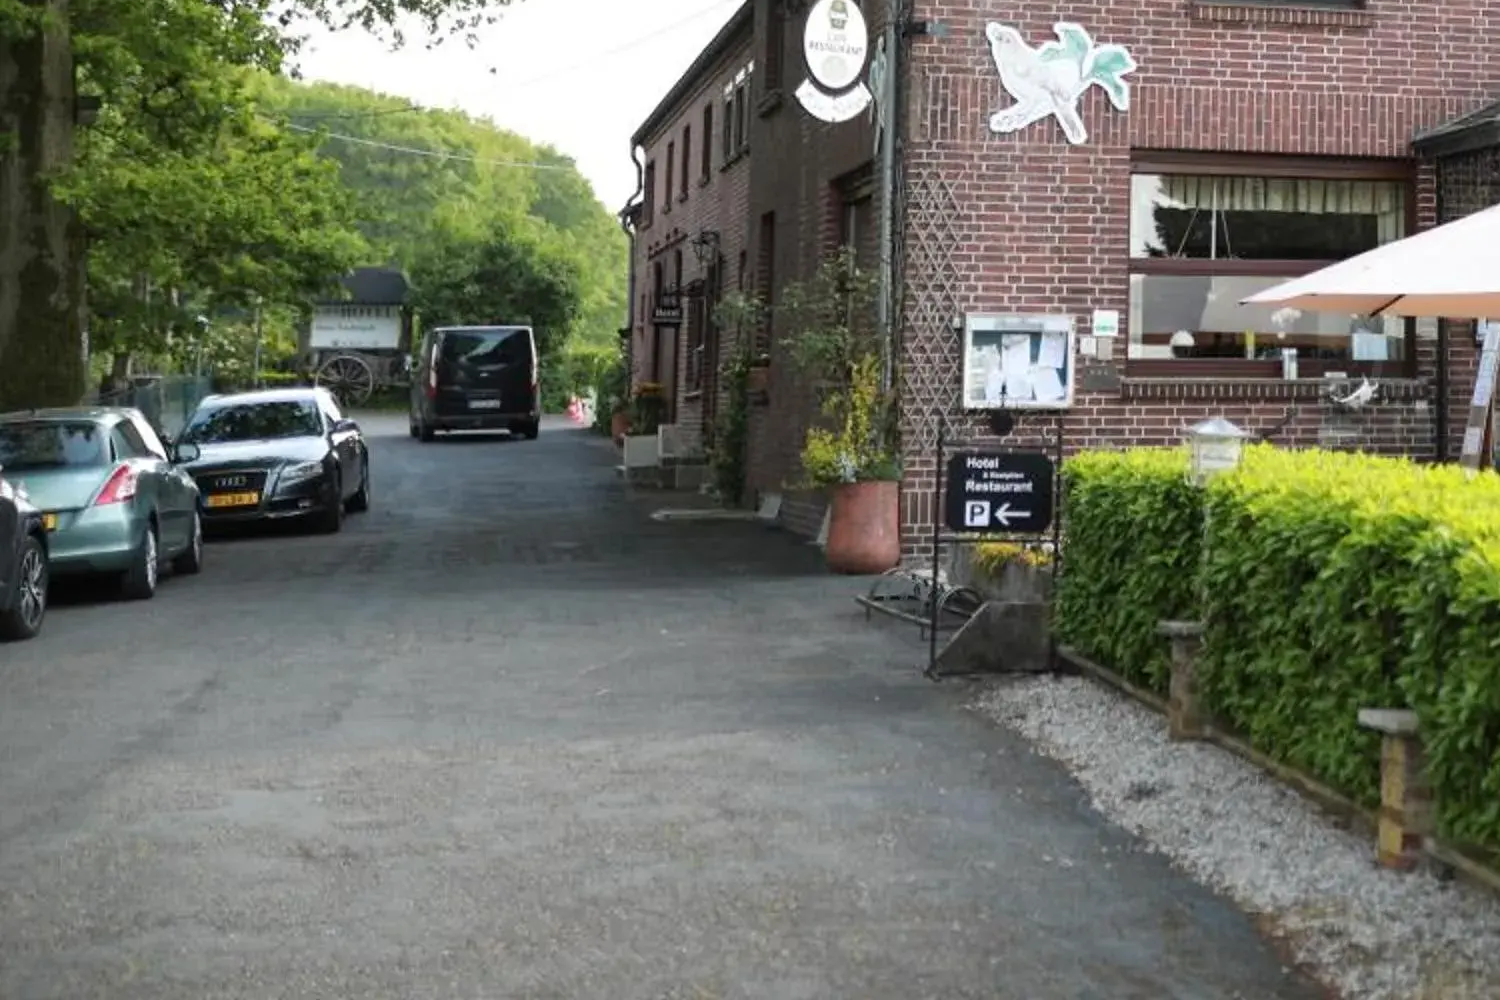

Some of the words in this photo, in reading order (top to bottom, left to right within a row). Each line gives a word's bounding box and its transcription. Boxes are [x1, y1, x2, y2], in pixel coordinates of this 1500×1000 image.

[966, 457, 999, 469] Hotel
[965, 480, 1033, 493] Restaurant
[970, 503, 985, 524] P
